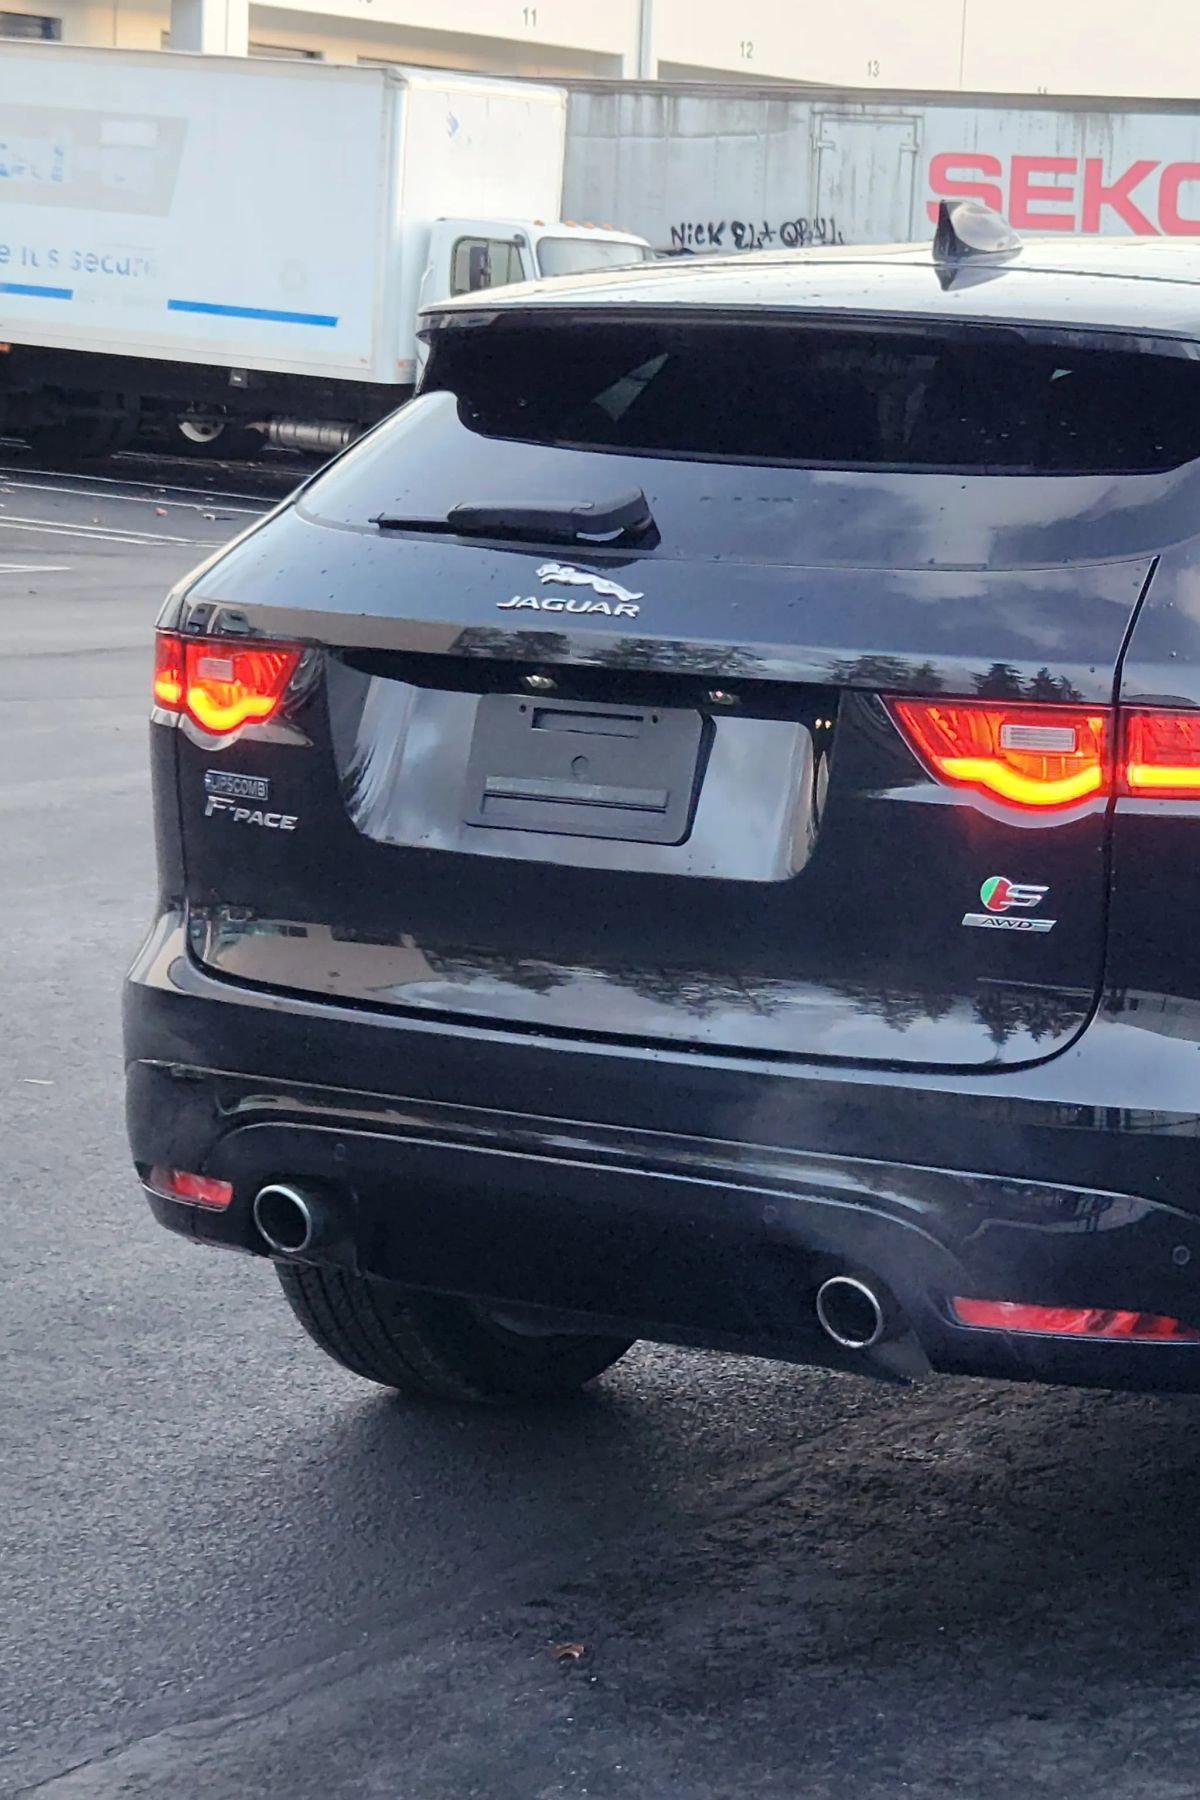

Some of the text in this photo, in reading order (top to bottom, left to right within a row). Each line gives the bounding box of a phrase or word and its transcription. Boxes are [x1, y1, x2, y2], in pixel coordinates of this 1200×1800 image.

[523, 7, 537, 27] 11
[739, 40, 754, 59] 12
[867, 59, 881, 78] 13
[496, 595, 641, 617] JAGUAR
[981, 917, 1033, 929] AWD
